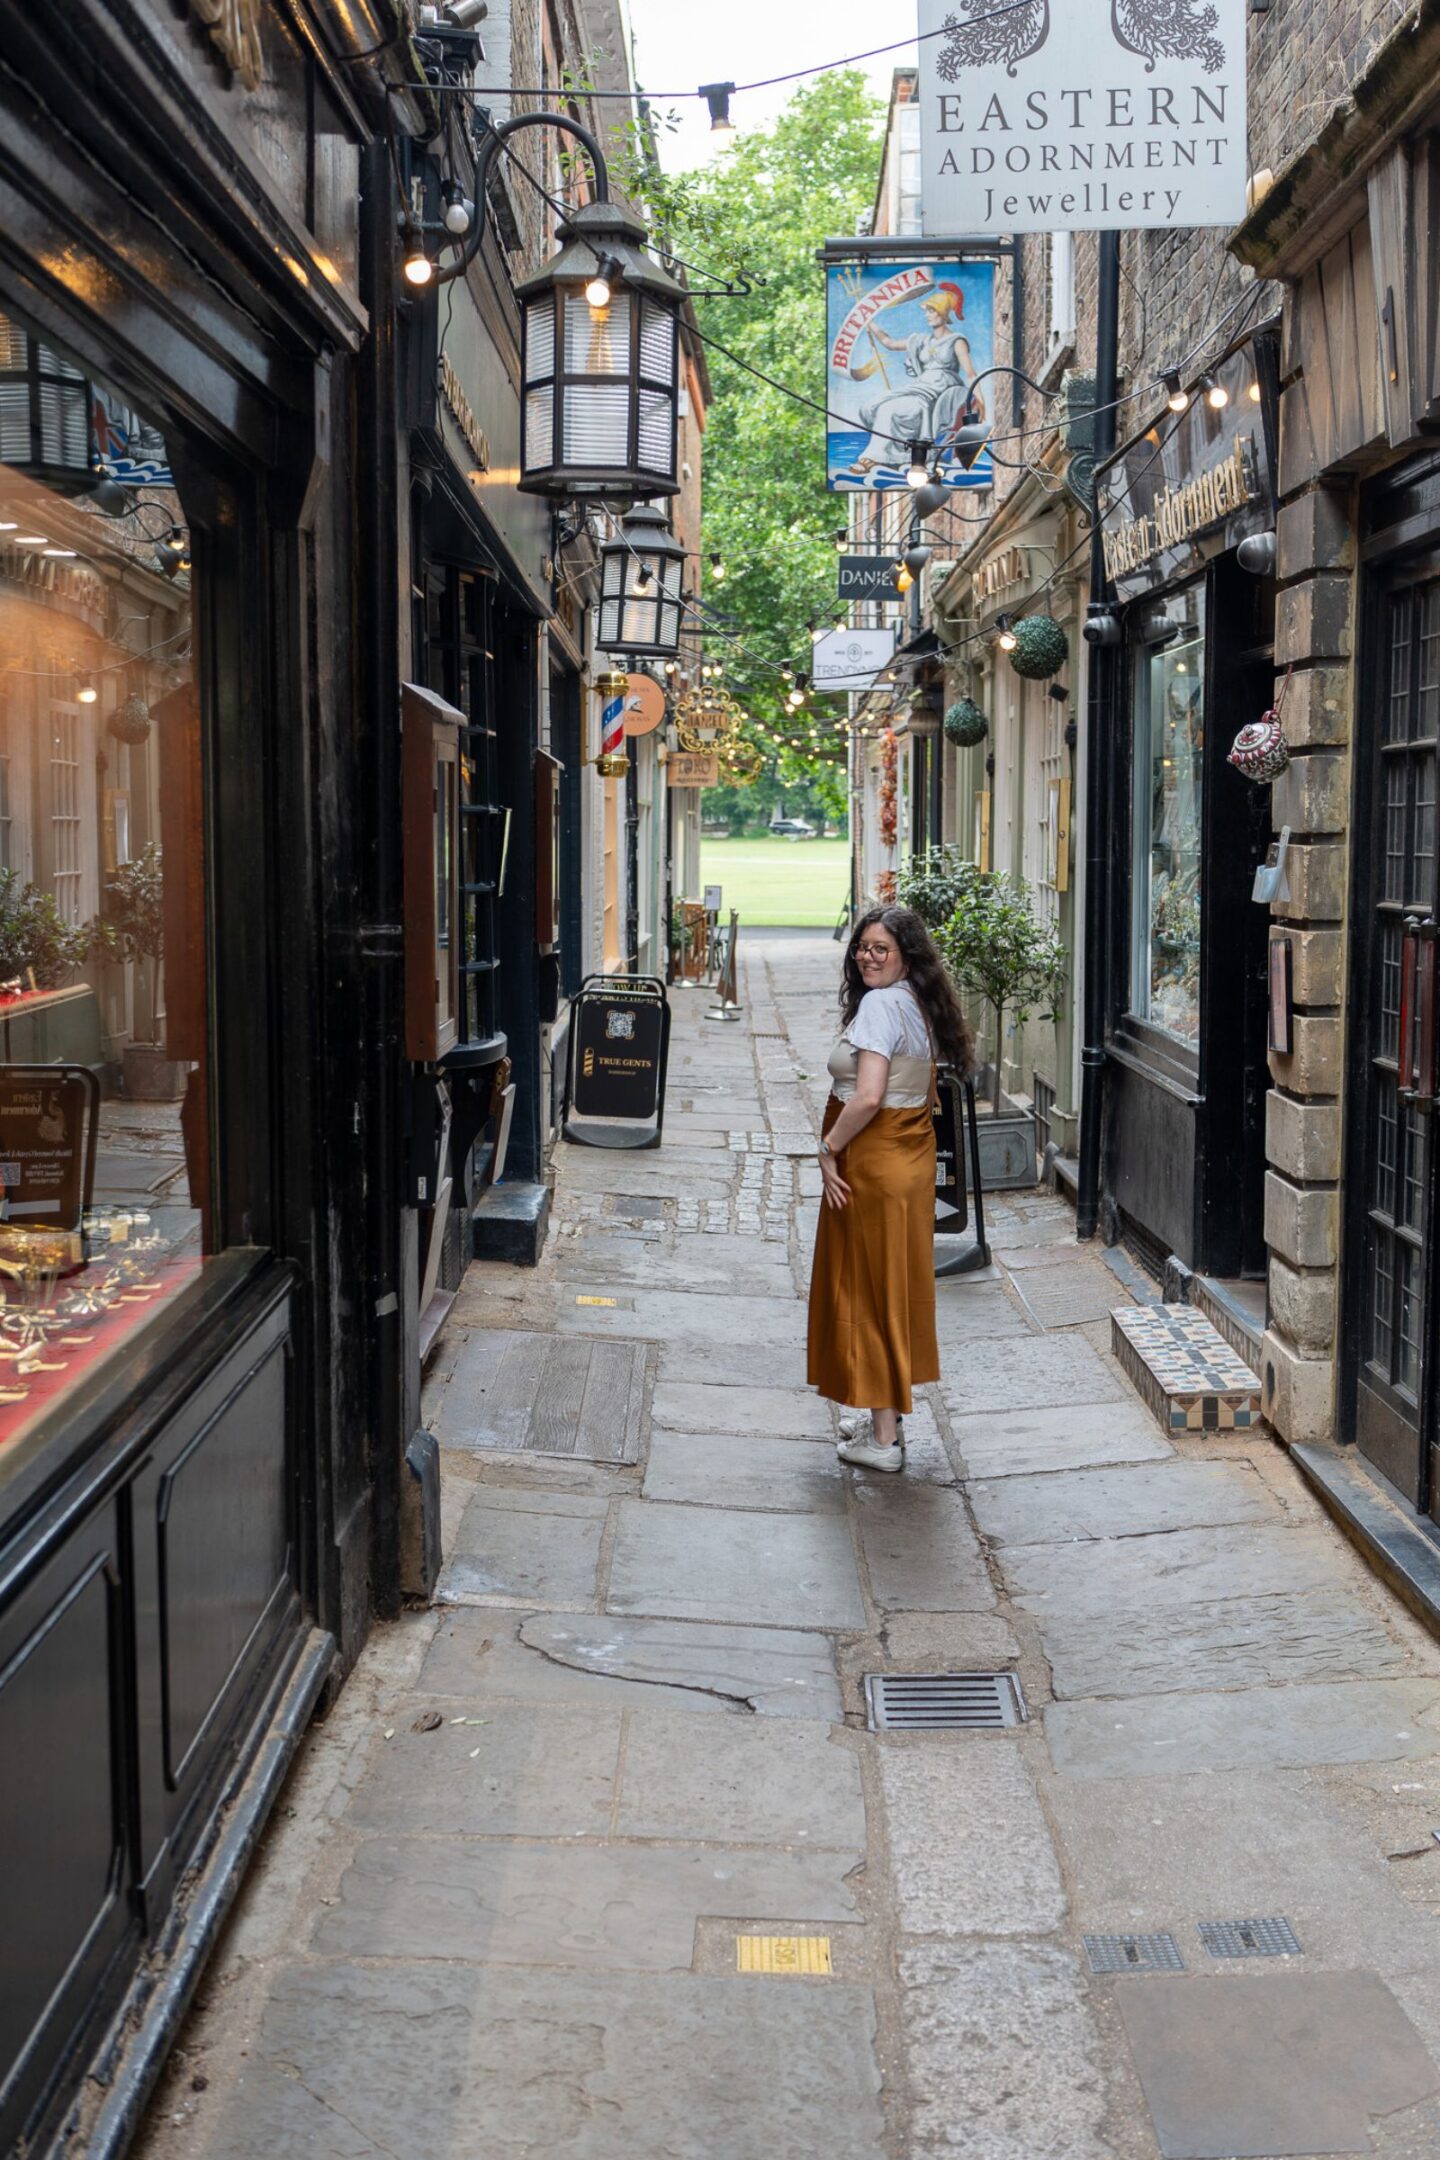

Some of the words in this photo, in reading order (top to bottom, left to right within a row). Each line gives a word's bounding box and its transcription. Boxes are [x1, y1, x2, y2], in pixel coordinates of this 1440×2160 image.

[936, 85, 1229, 133] EASTERN
[937, 138, 1228, 175] ADORNMENT
[983, 183, 1182, 222] Jewellery
[832, 269, 929, 369] BRITANNIA
[598, 1057, 621, 1066] TRUE
[622, 1058, 652, 1068] GENTS
